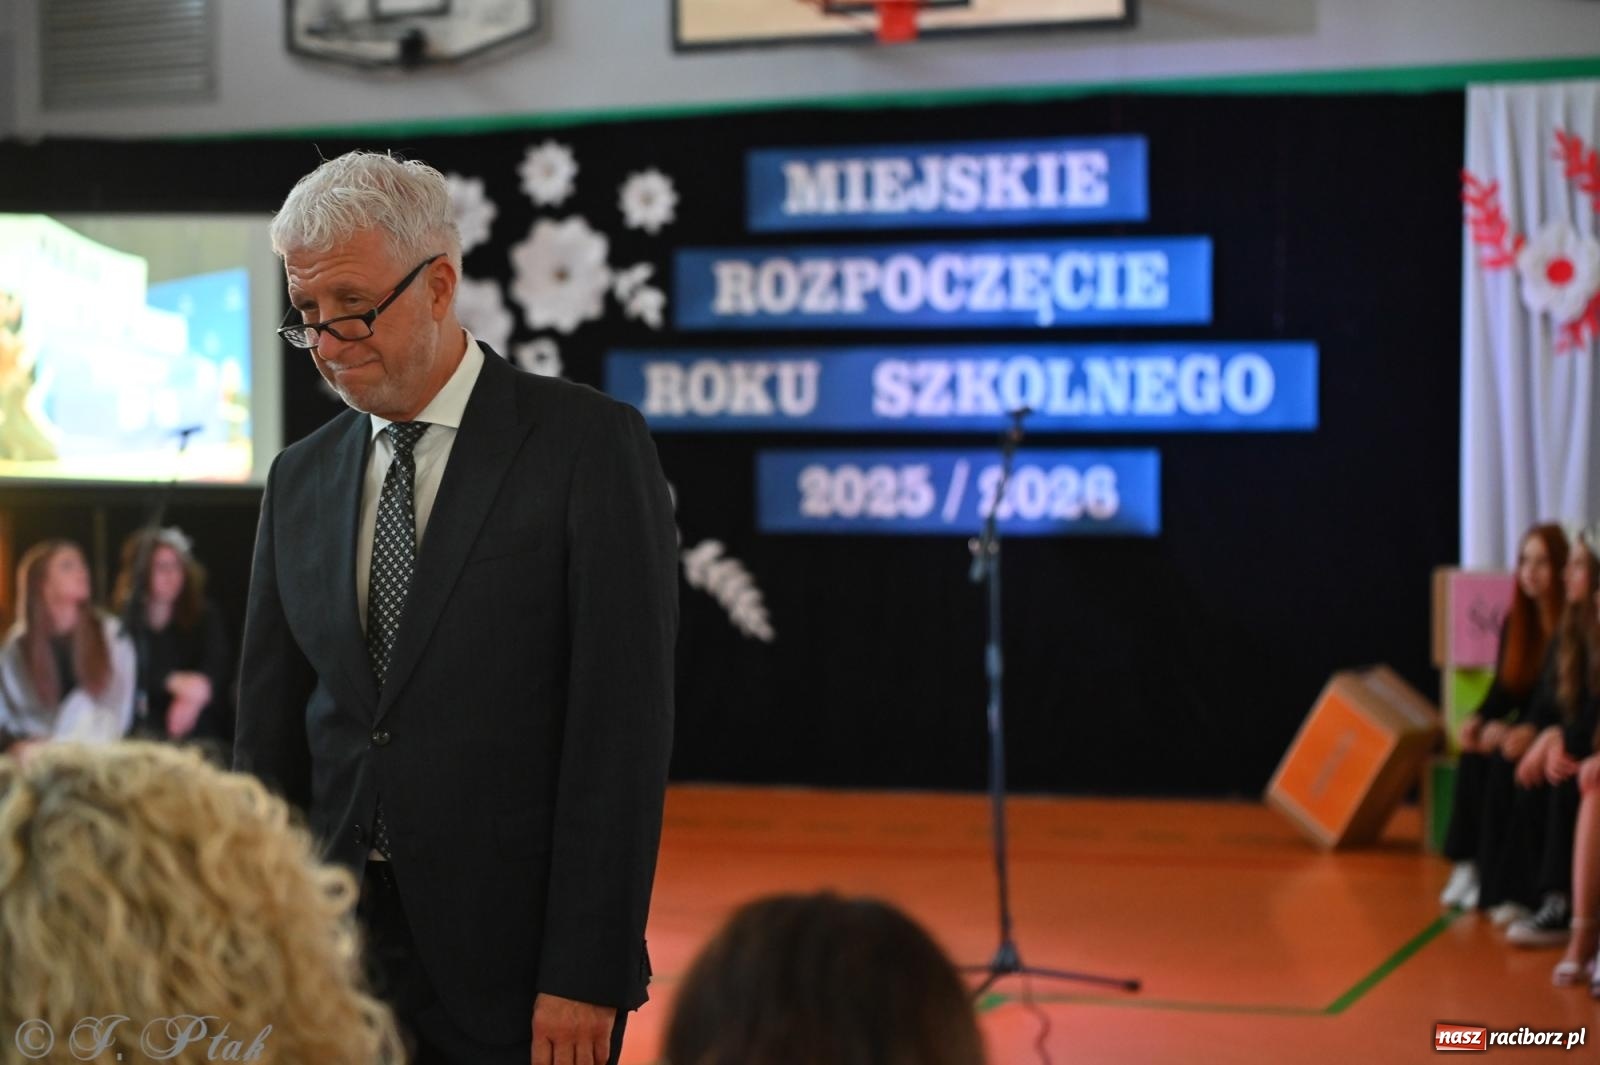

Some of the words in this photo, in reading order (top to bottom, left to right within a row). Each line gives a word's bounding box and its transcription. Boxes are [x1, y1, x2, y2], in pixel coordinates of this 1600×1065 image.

[783, 150, 1109, 215] MIEJSKIE
[713, 251, 1169, 326] ROZPOCZĘCIE
[643, 360, 820, 416] ROKU
[872, 355, 1275, 417] SZKOLNEGO
